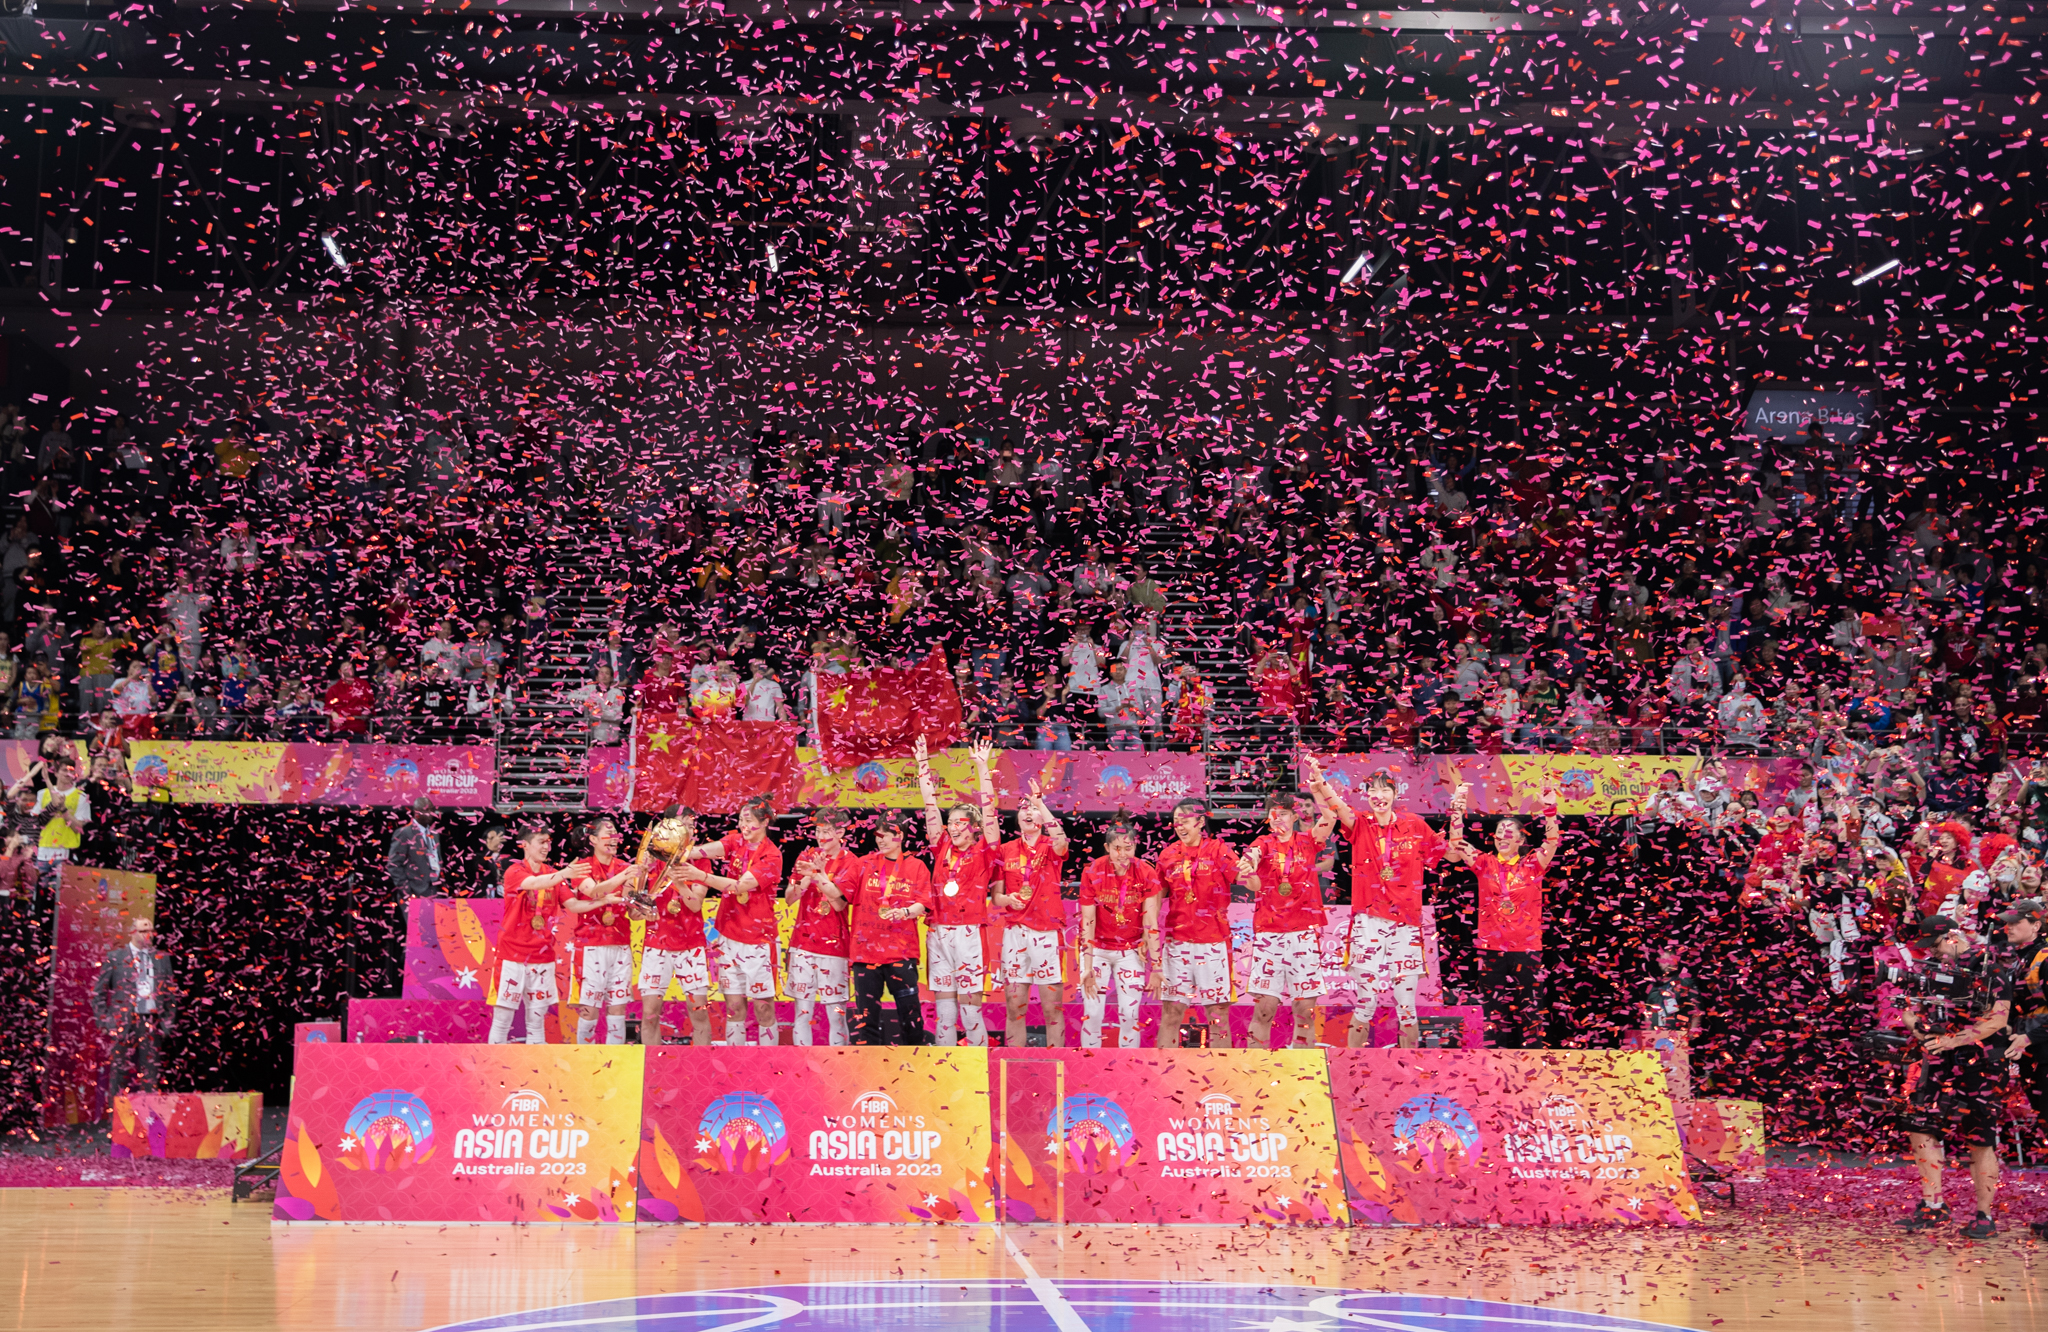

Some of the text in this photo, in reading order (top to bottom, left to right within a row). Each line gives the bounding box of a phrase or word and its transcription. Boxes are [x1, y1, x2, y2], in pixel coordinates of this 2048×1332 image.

[427, 774, 479, 788] ASIA CUP
[607, 988, 631, 999] TCL
[749, 982, 768, 994] CL
[511, 1098, 540, 1112] FIBA
[861, 1100, 889, 1113] FIBA
[1204, 1102, 1233, 1115] FIBA
[472, 1113, 575, 1127] WOMEN'S
[823, 1115, 925, 1128] WOMEN'S
[1168, 1117, 1271, 1130] WOMEN'S
[453, 1128, 590, 1159] ASIA CUP
[809, 1129, 942, 1160] ASIA CUP
[1156, 1132, 1288, 1162] ASIA CUP
[1503, 1133, 1633, 1163] ASIA CUP
[452, 1162, 587, 1175] Australia 2023
[809, 1163, 943, 1176] Australia 2023
[1160, 1165, 1292, 1178] Australia 2023
[1511, 1166, 1591, 1179] Australia
